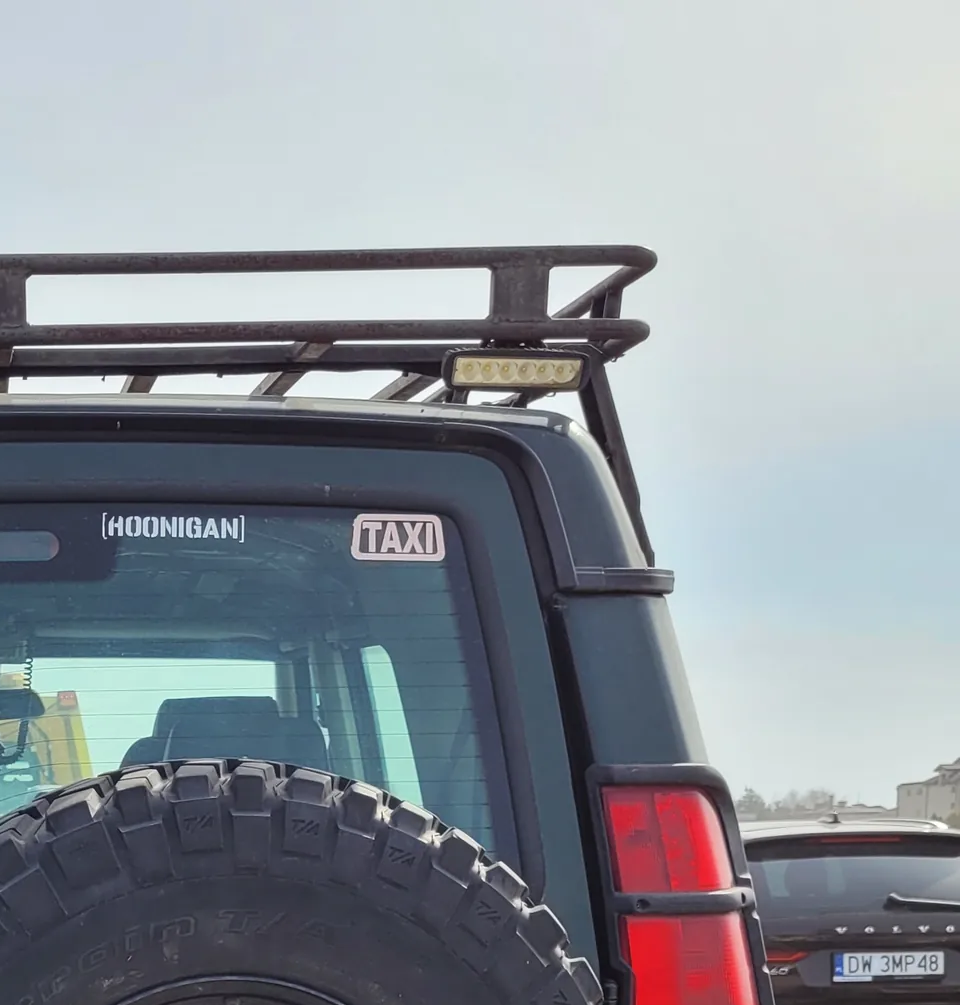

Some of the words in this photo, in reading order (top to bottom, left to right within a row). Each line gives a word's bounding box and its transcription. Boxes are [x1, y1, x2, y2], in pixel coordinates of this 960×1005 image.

[362, 521, 434, 555] TAXI
[835, 925, 956, 935] VOLVO
[848, 955, 872, 974] DW
[880, 954, 939, 973] 3MP48
